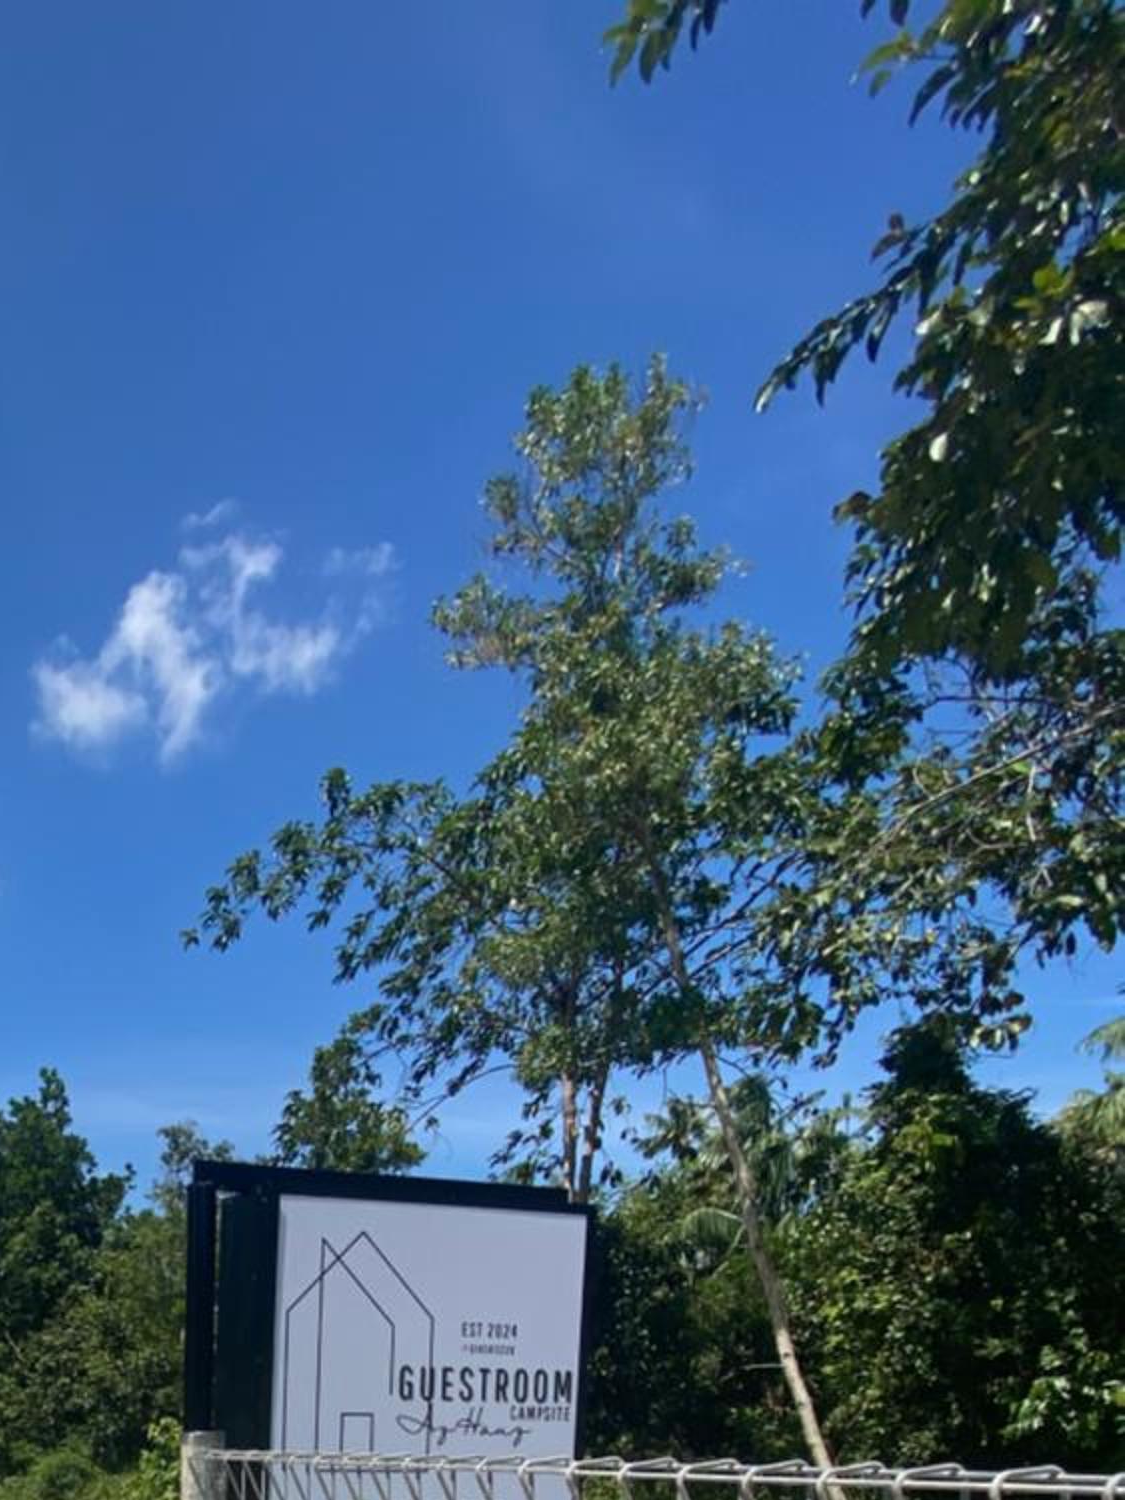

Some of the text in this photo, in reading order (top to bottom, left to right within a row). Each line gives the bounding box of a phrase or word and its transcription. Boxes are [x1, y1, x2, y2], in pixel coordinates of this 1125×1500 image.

[461, 1321, 518, 1339] EST 2024
[398, 1364, 572, 1404] GUESTROOM
[509, 1405, 571, 1422] CAMPSITE
